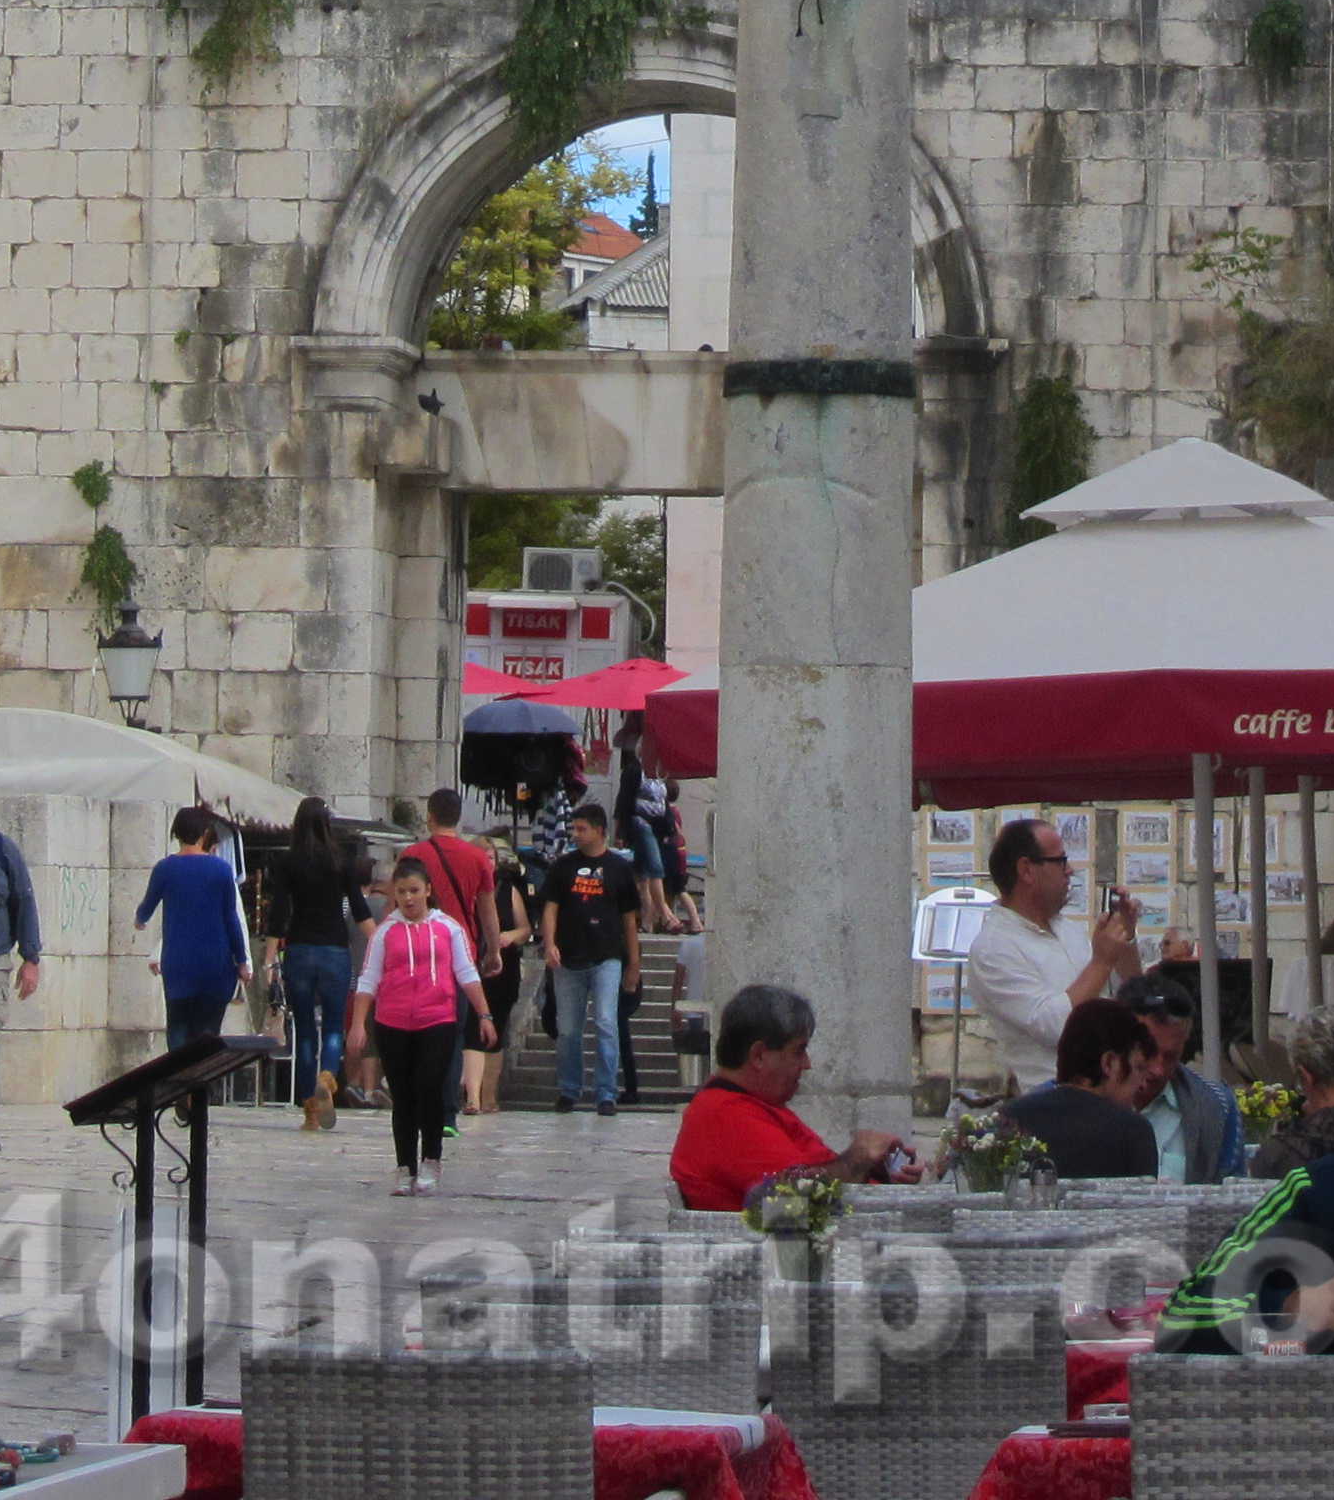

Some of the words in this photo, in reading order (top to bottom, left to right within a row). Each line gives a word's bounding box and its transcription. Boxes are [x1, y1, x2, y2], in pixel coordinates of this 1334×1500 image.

[506, 612, 562, 629] TISAK
[505, 660, 561, 676] TISAK
[1232, 708, 1313, 739] caffe
